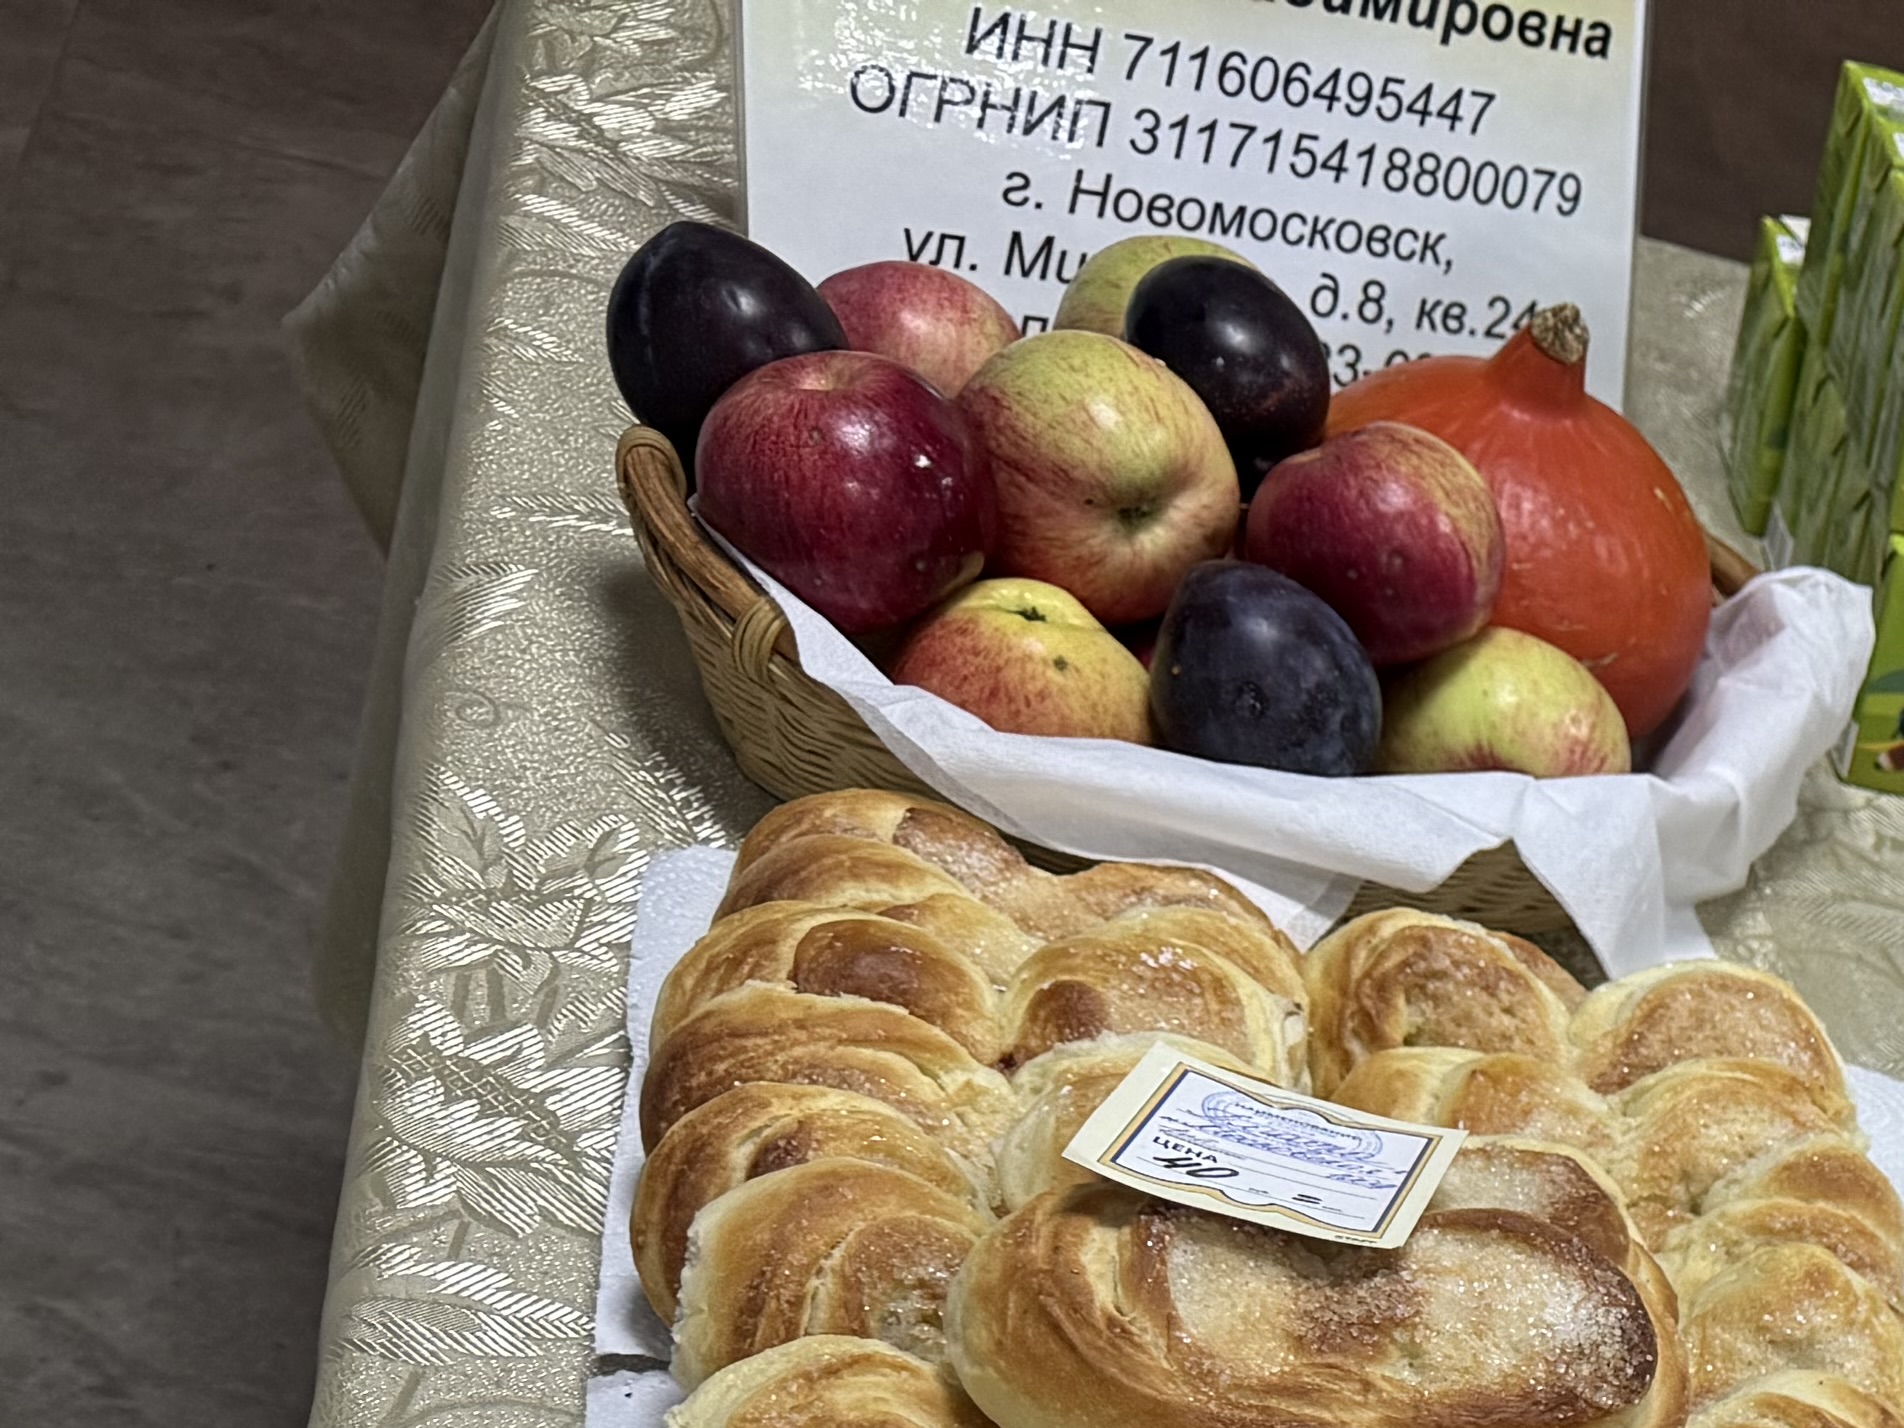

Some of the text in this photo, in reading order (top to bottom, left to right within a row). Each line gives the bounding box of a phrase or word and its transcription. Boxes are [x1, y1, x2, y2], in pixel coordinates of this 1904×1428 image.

[965, 5, 1497, 135] ИНН 711606495447
[850, 63, 1582, 217] ОГРНИП 311715418800079
[904, 227, 978, 271] ул.
[1003, 169, 1454, 275] г. Новомосковск,
[1152, 1136, 1218, 1164] ЦЕНА
[1152, 1156, 1240, 1179] 40
